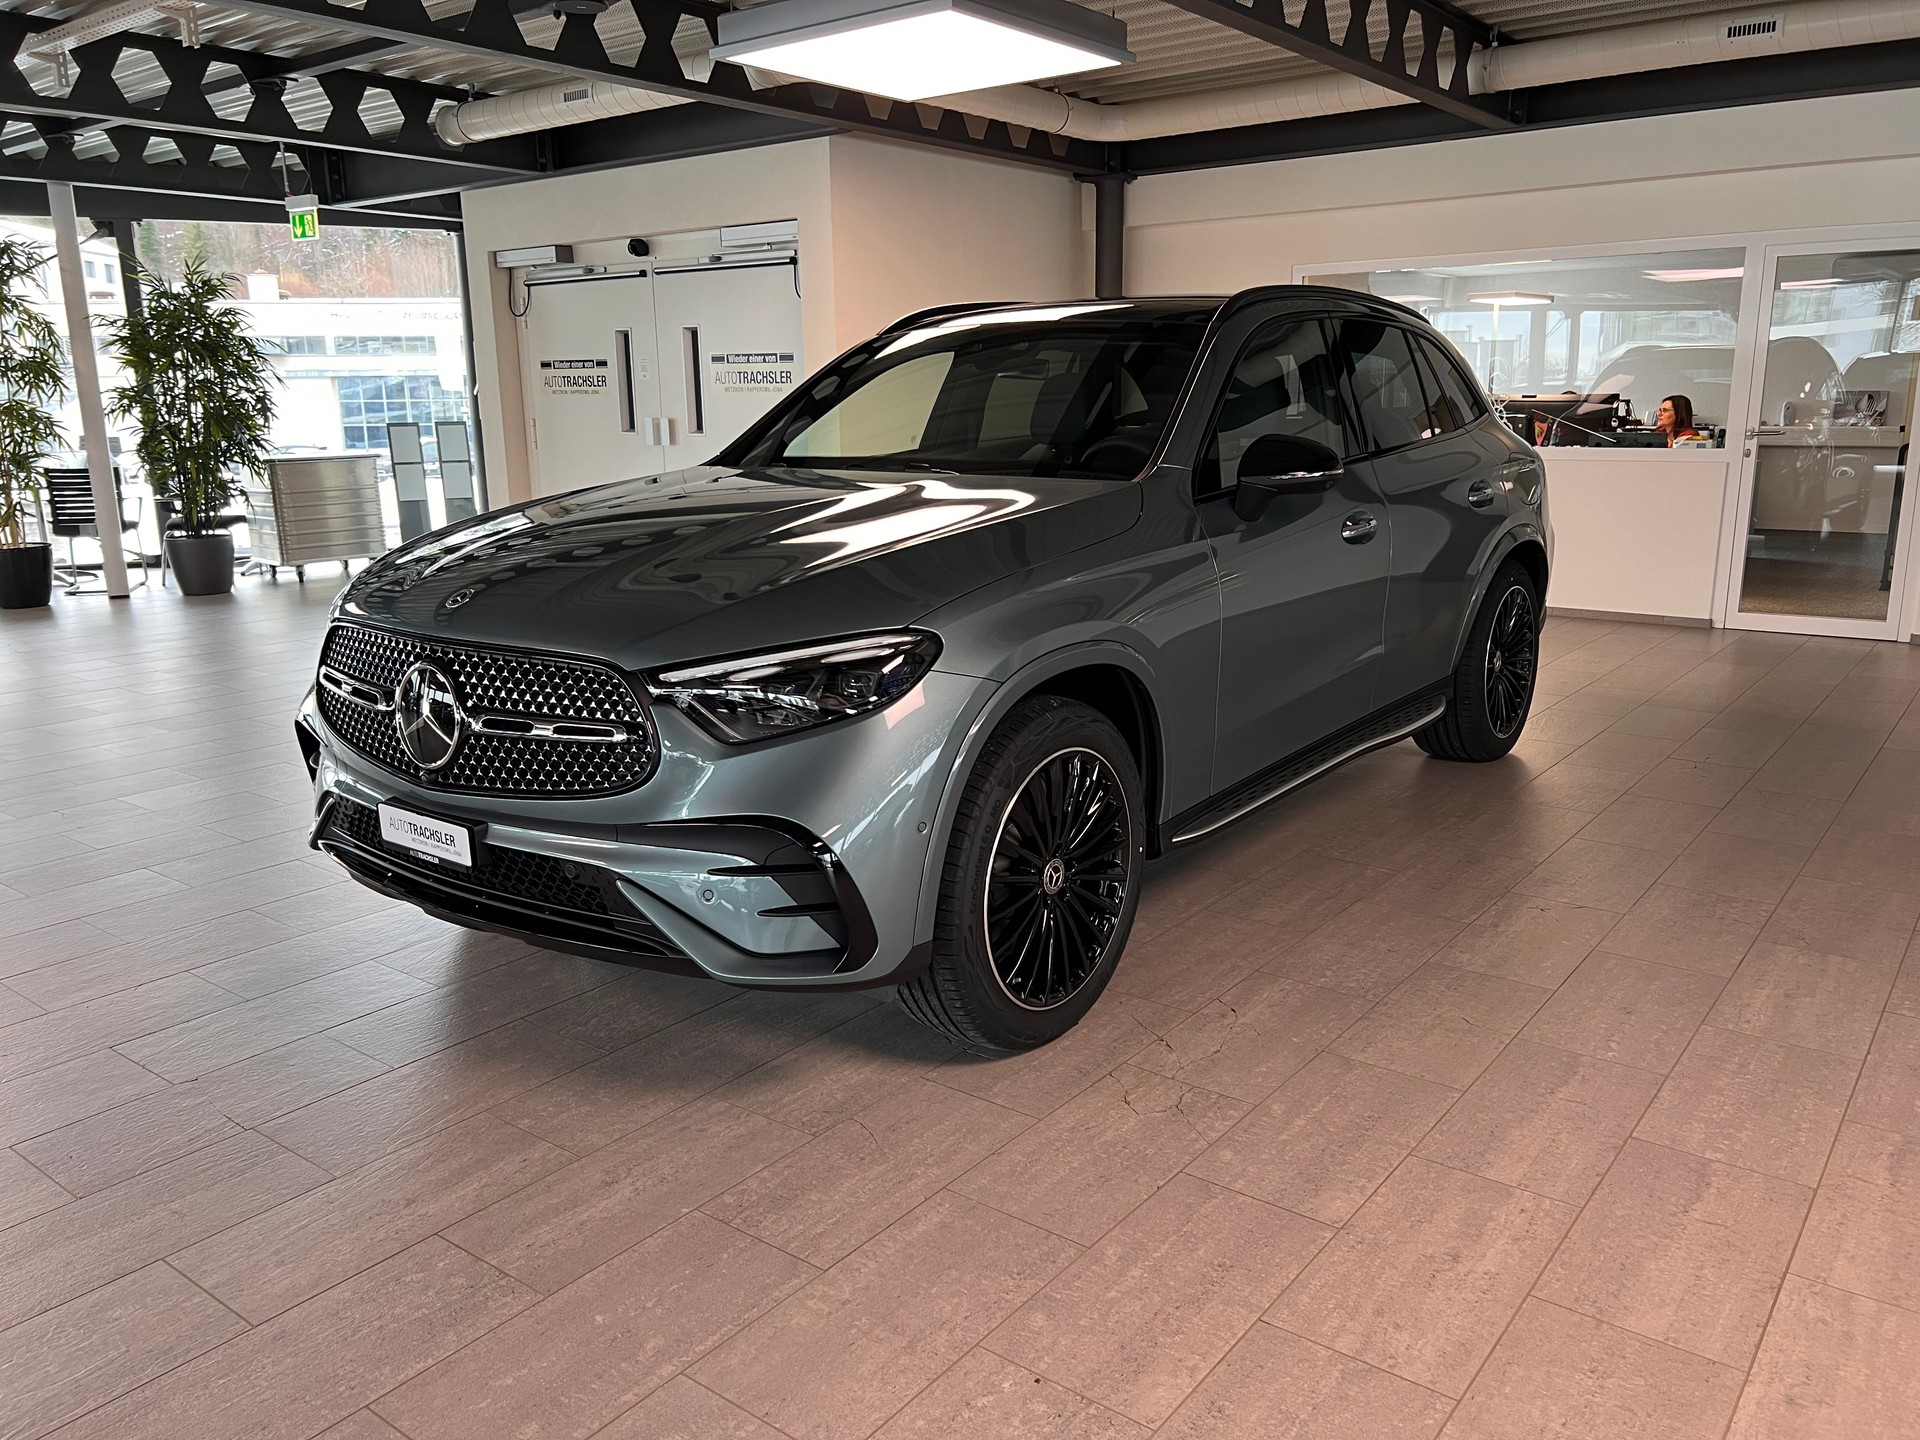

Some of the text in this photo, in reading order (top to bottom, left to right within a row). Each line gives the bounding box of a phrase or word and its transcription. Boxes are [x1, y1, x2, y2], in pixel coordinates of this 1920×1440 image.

[554, 360, 594, 369] Wieder einer von
[728, 354, 776, 363] Wieder einer von
[544, 375, 607, 388] AUTOTRACHSLER
[715, 370, 792, 384] AUTOTRACHSLER
[389, 816, 457, 848] AUTOTRACHSLER
[969, 846, 986, 914] EcoContact
